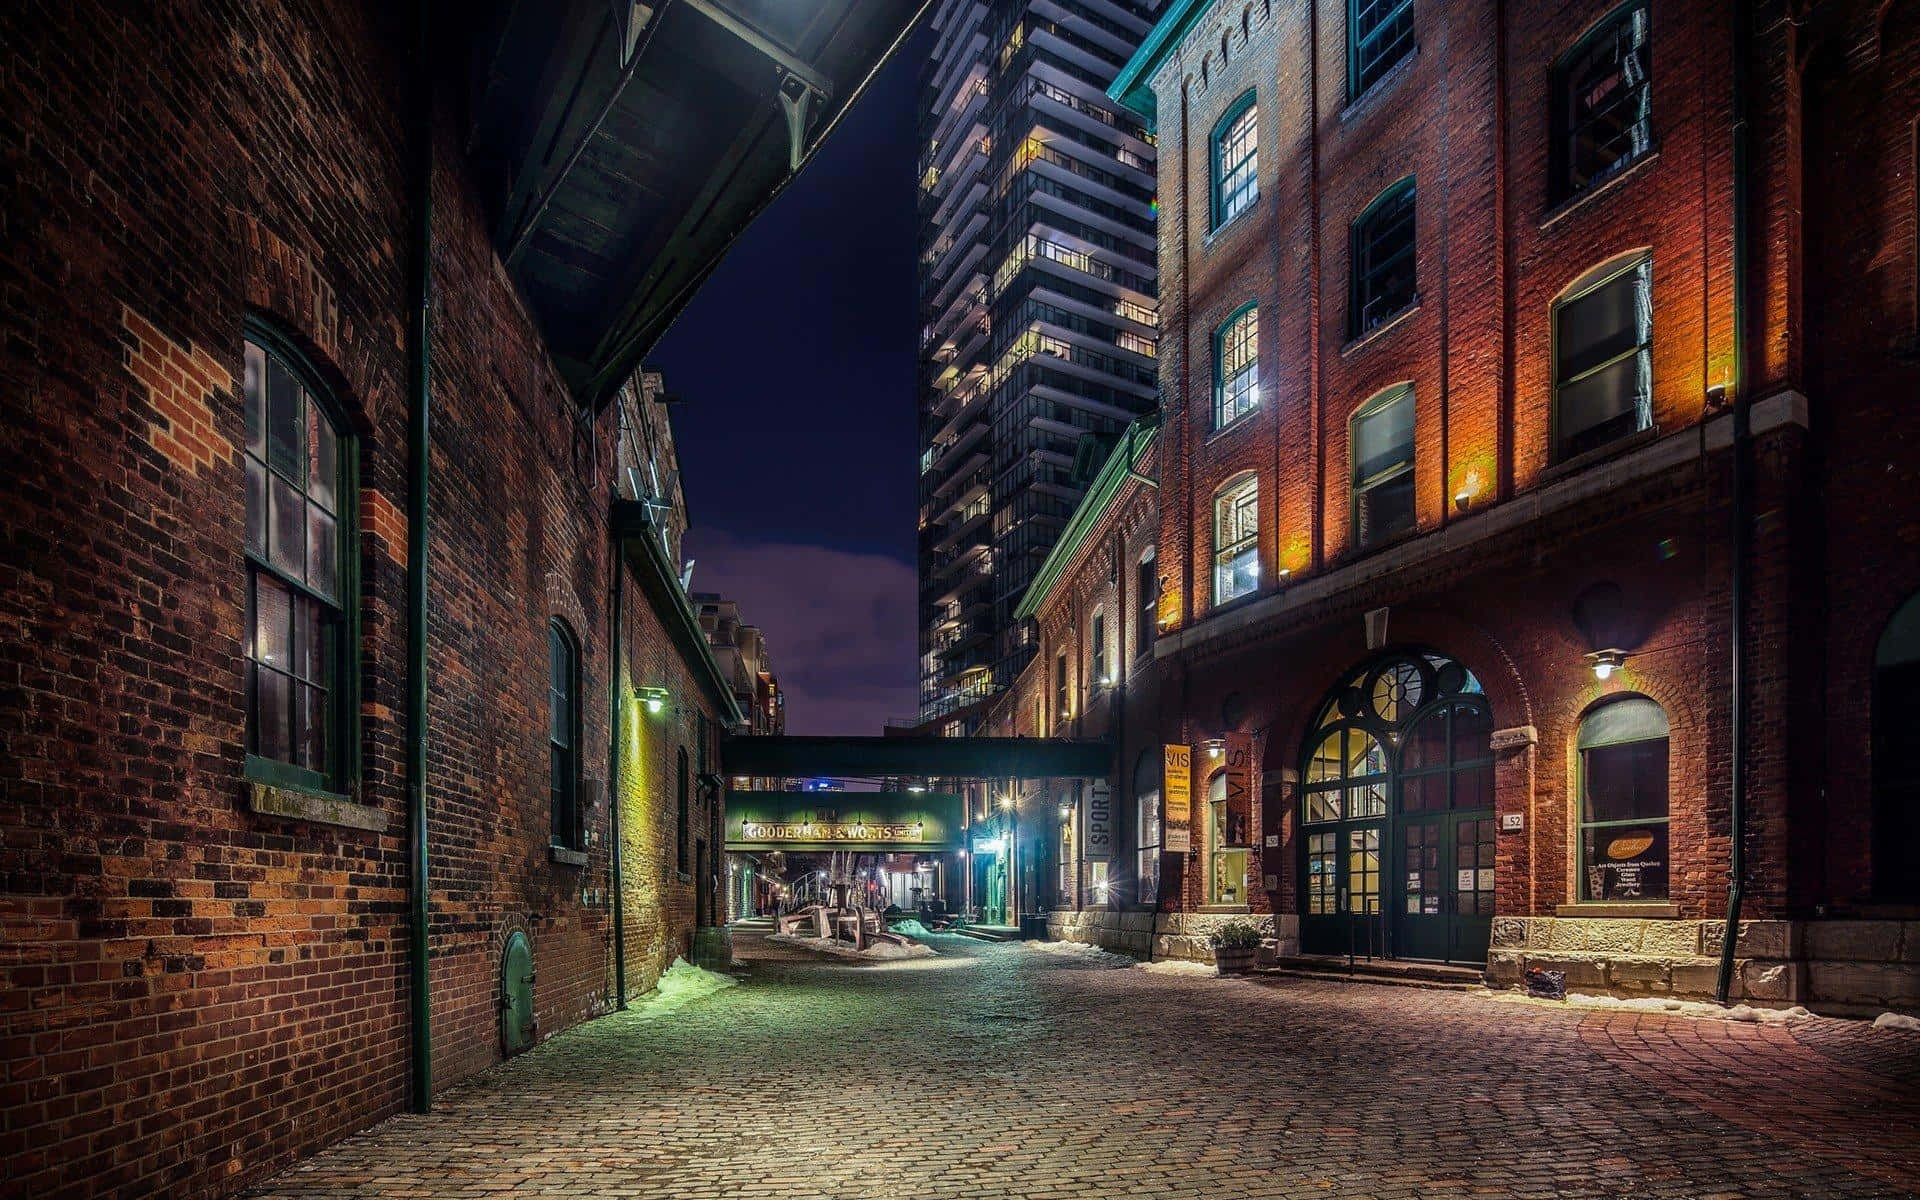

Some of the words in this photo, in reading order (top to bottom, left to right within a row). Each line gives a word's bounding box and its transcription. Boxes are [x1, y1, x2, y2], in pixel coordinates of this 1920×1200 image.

[1166, 752, 1189, 767] VIS
[1227, 749, 1244, 798] VIS
[1091, 787, 1109, 845] SPORT
[1510, 816, 1521, 827] 52
[835, 825, 846, 839] &
